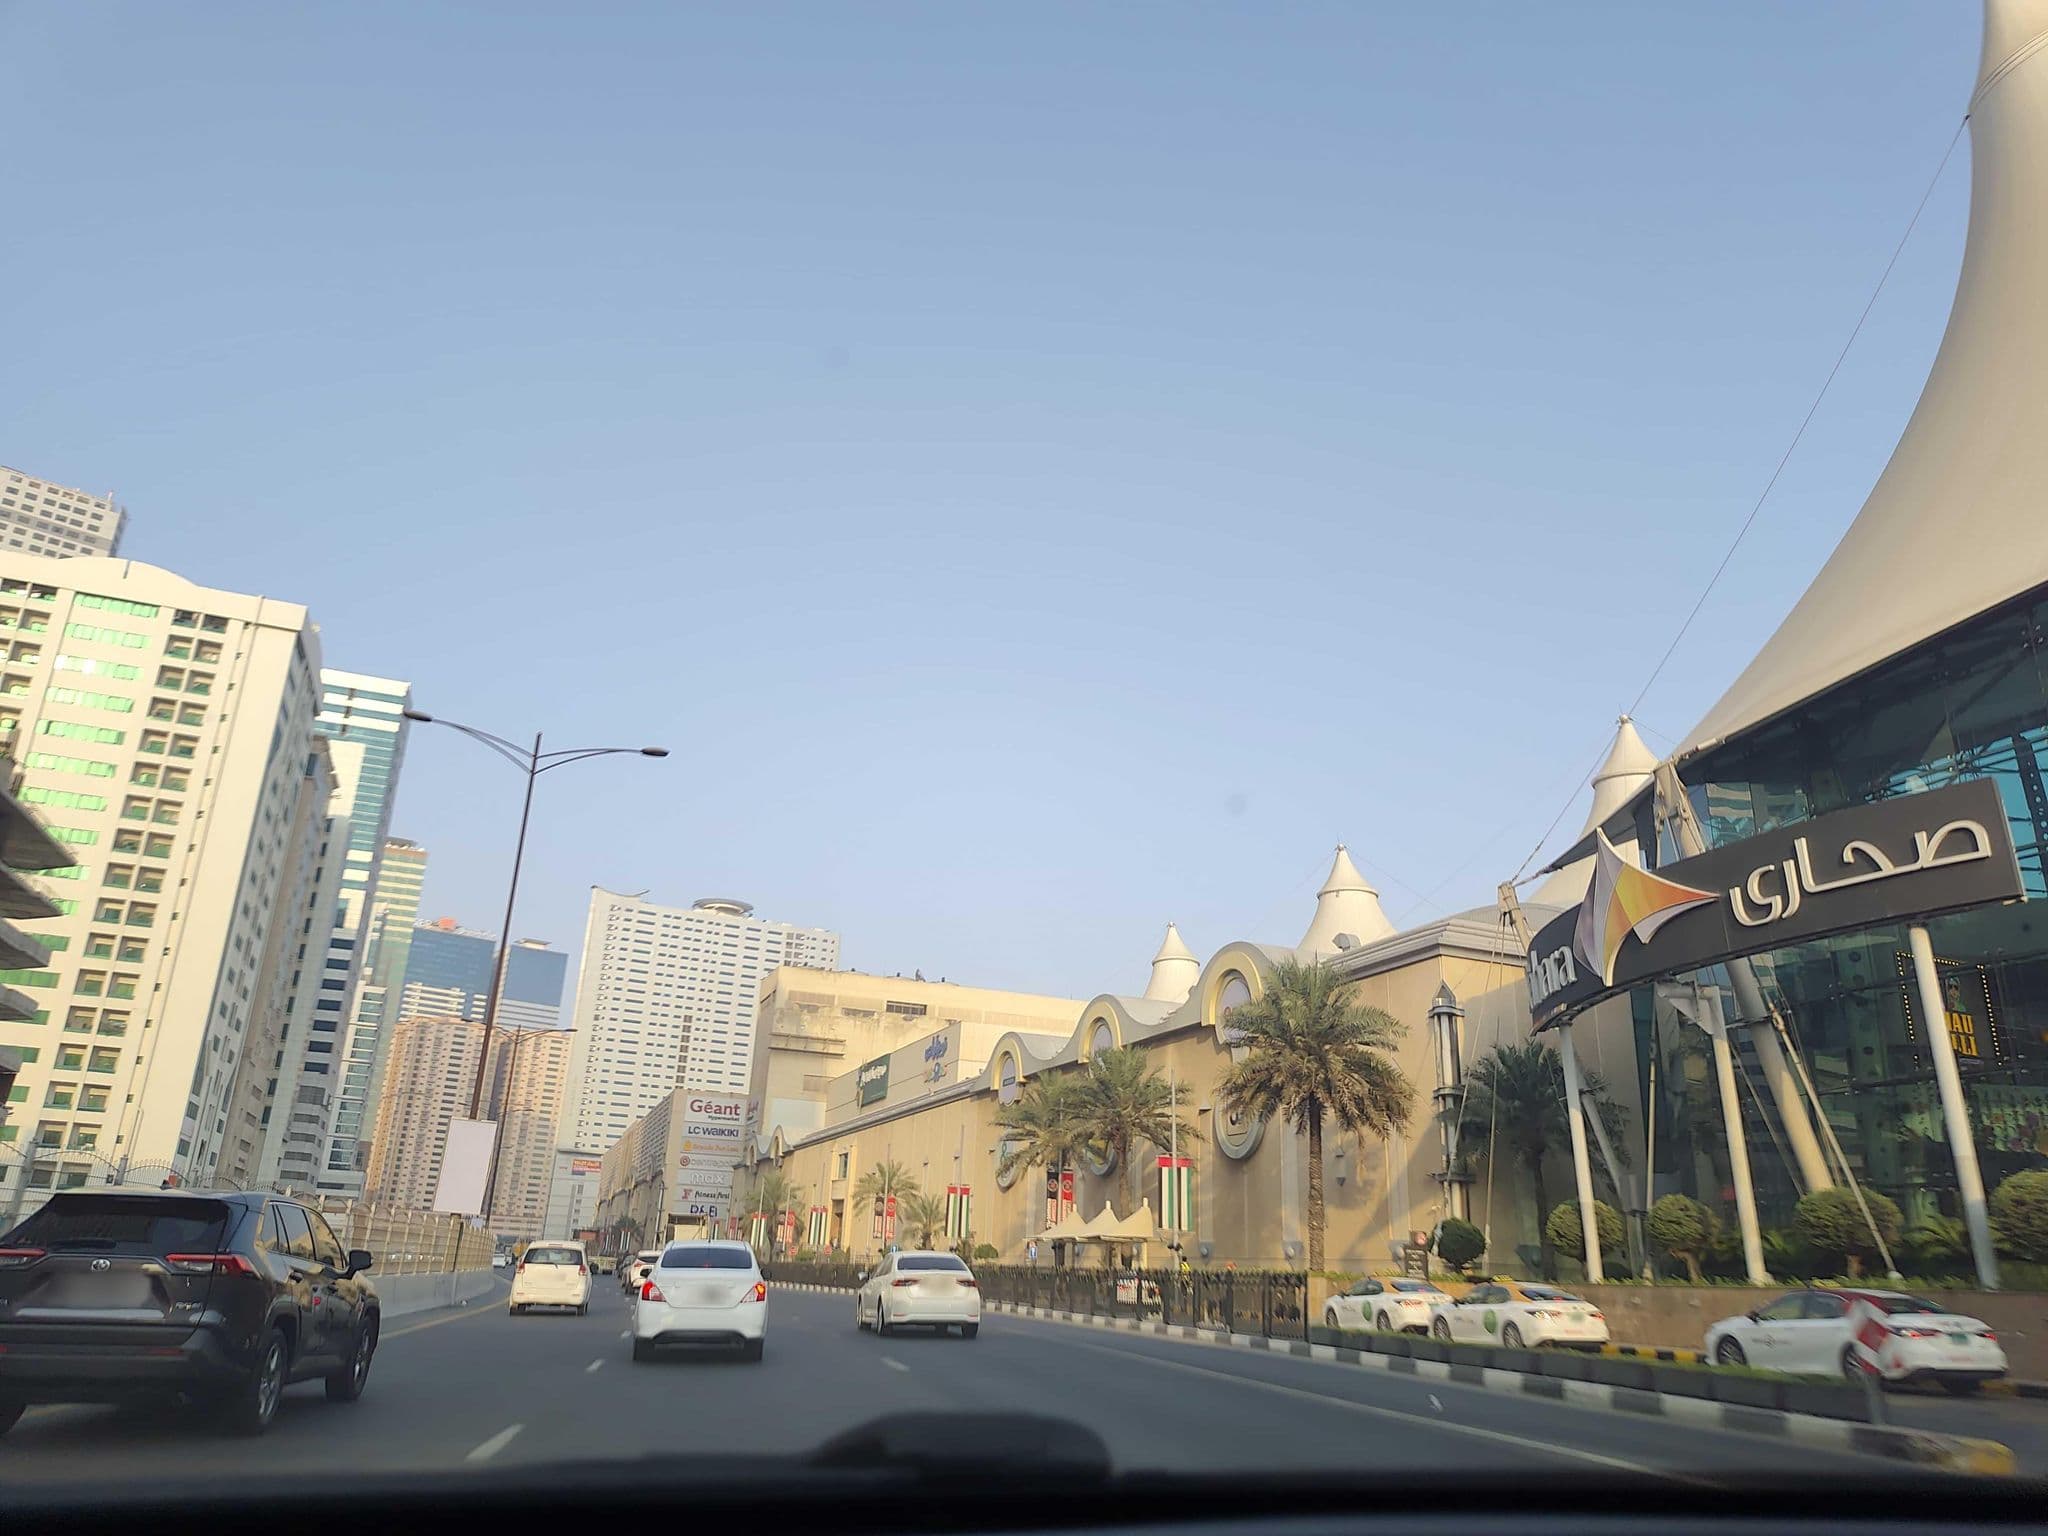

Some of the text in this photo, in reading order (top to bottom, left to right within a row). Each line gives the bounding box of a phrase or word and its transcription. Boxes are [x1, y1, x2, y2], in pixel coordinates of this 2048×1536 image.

[1529, 945, 1578, 1013] hara
[690, 1099, 741, 1117] Géant
[688, 1126, 701, 1135] LC
[690, 1171, 725, 1185] max
